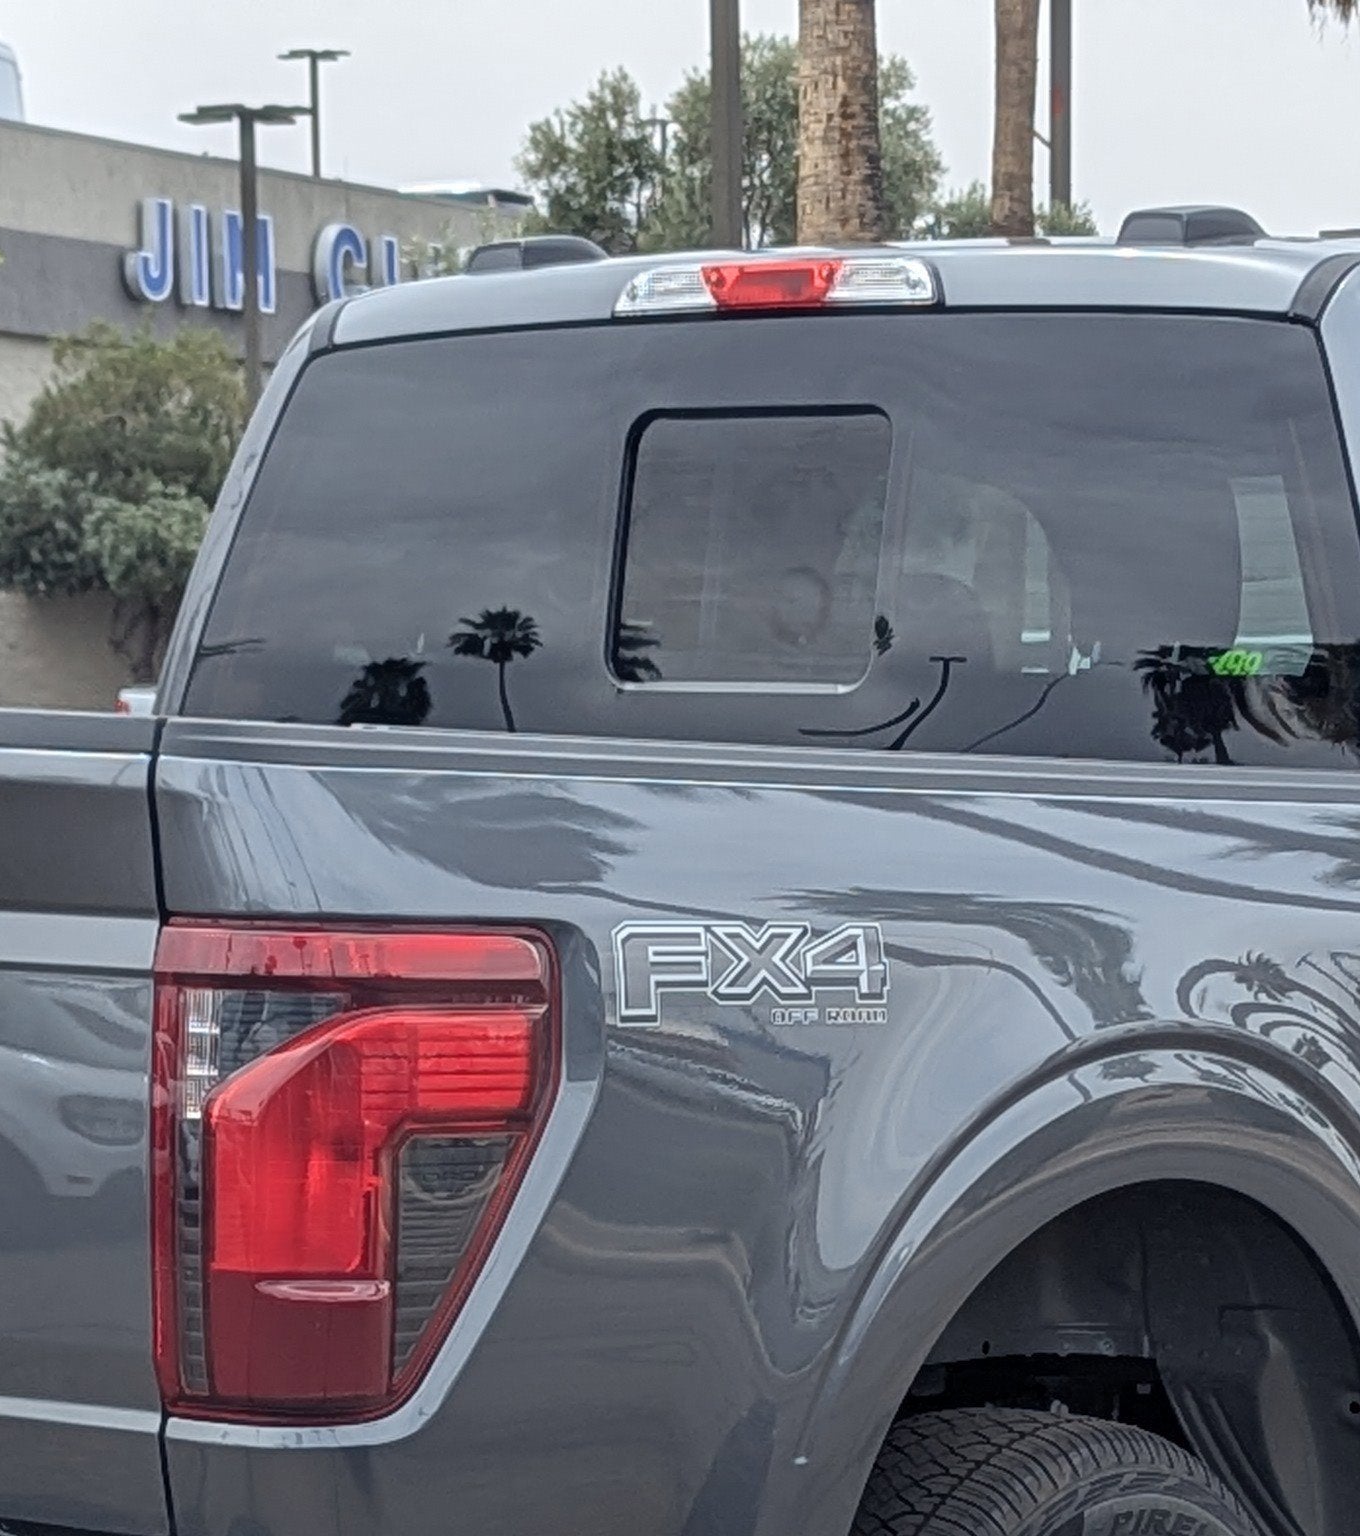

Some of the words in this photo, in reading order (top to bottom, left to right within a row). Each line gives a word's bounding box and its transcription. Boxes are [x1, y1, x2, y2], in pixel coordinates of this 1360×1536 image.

[126, 198, 276, 314] JIM
[611, 920, 889, 1027] FX4
[771, 1008, 819, 1025] OFF
